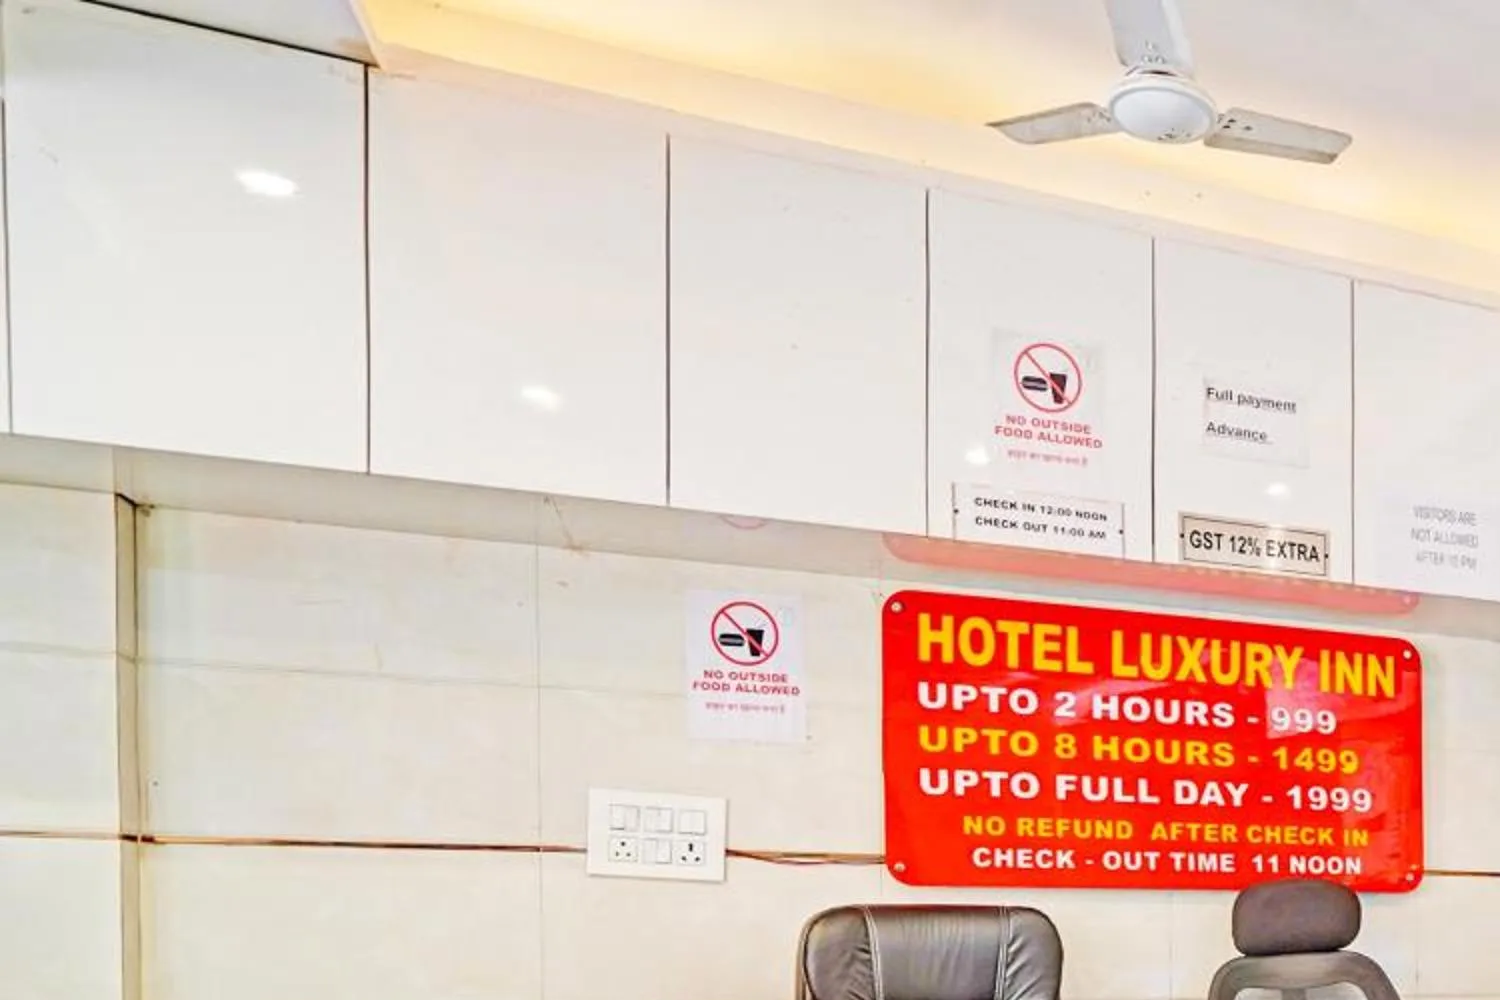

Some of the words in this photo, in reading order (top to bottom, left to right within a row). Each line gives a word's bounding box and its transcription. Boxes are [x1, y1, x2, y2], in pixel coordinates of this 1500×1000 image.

[1206, 387, 1233, 401] Full
[1236, 392, 1297, 413] payment
[994, 425, 1033, 440] FOOD
[1037, 432, 1103, 449] ALLOWED
[1005, 415, 1026, 425] NO
[1031, 417, 1092, 434] OUTSIDE
[1205, 421, 1268, 442] Advance
[974, 496, 1018, 511] CHECK
[1022, 503, 1035, 513] IN
[1040, 505, 1072, 517] 12:00
[1075, 510, 1107, 522] NOON
[975, 516, 1018, 530] CHECK
[1023, 521, 1048, 534] OUT
[1053, 526, 1085, 538] 11:00
[1088, 529, 1106, 540] AM
[1189, 530, 1223, 551] GST
[1229, 536, 1261, 557] 12%
[1265, 540, 1320, 563] EXTRA
[917, 612, 1095, 675] HOTEL
[1111, 630, 1304, 691] LUXURY
[1318, 649, 1395, 699] INN
[693, 681, 731, 692] FOOD
[735, 683, 801, 696] ALLOWED
[703, 670, 725, 679] NO
[728, 671, 789, 683] OUTSIDE
[917, 681, 1039, 715] UPTO
[1054, 691, 1077, 718] 2
[1092, 693, 1235, 728] HOURS
[1270, 705, 1337, 735] 999
[918, 725, 1039, 758] UPTO
[1054, 733, 1077, 760] 8
[1092, 735, 1235, 769] HOURS
[1272, 746, 1360, 775] 1499
[919, 768, 1041, 800] UPTO
[1055, 774, 1161, 805] FULL
[1173, 778, 1250, 808] DAY
[1286, 785, 1373, 814] 1999
[963, 816, 1007, 835] NO
[1016, 817, 1134, 840] REFUND
[1150, 822, 1238, 844] AFTER
[1246, 825, 1334, 847] CHECK
[1343, 829, 1369, 847] IN
[972, 847, 1076, 869] CHECK
[1102, 851, 1160, 872] OUT
[1168, 852, 1236, 873] TIME
[1252, 855, 1279, 873] 11
[1289, 856, 1363, 876] NOON
